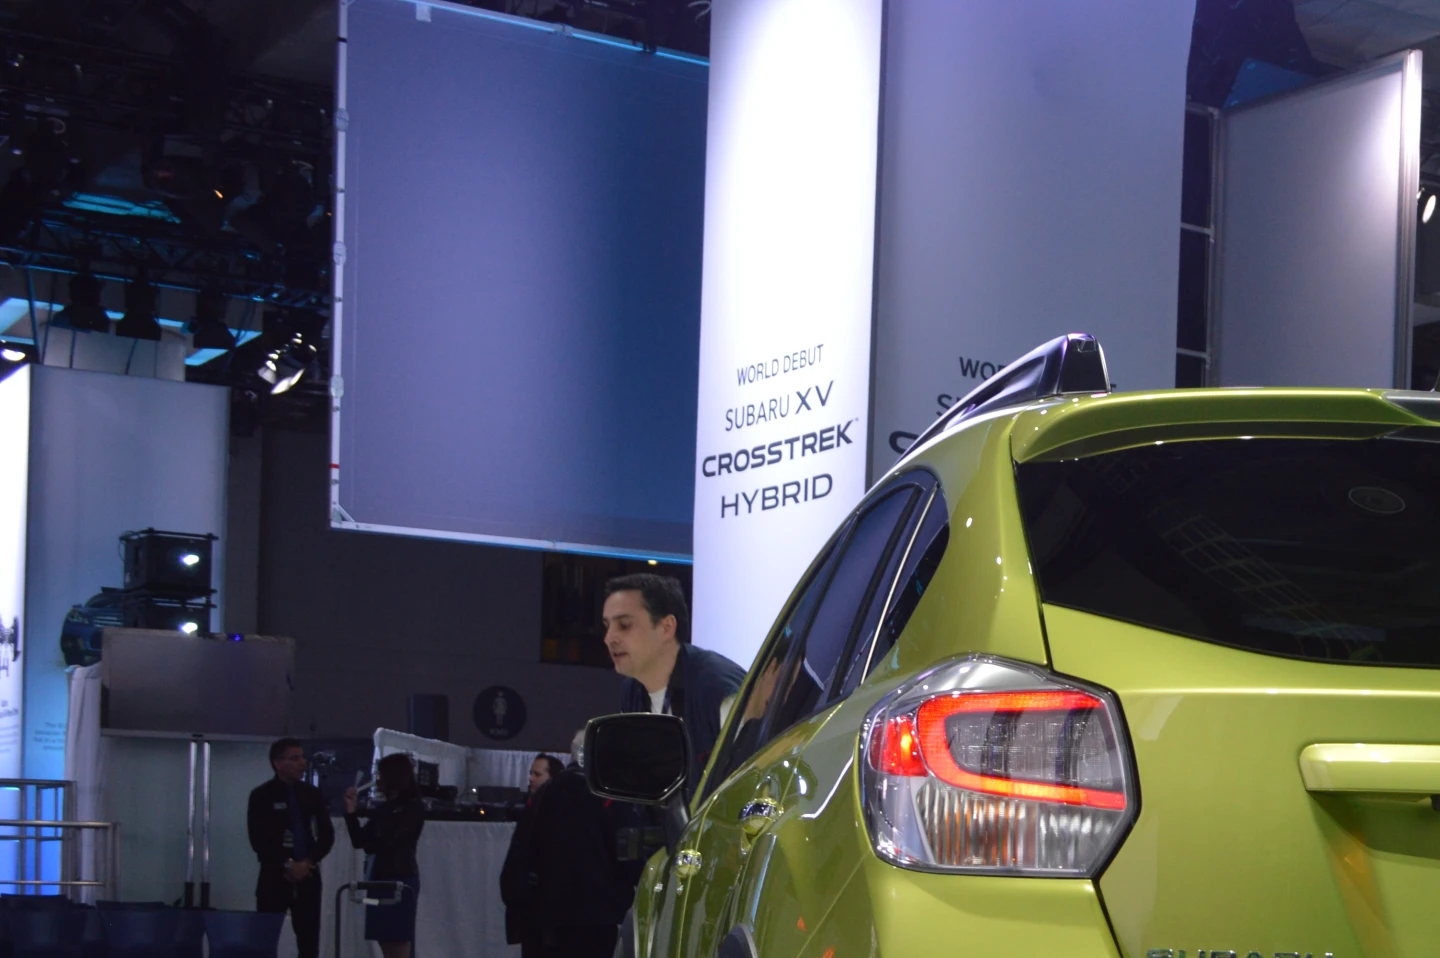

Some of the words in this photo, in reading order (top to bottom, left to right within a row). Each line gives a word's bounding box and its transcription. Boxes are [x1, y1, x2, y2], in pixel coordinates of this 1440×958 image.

[736, 358, 779, 386] WORLD
[783, 344, 824, 372] DEBUT
[959, 356, 1006, 381] WO
[725, 394, 790, 432] SUBARU
[795, 380, 834, 414] XV
[702, 418, 854, 478] CROSSTREK
[720, 473, 833, 519] HYBRID
